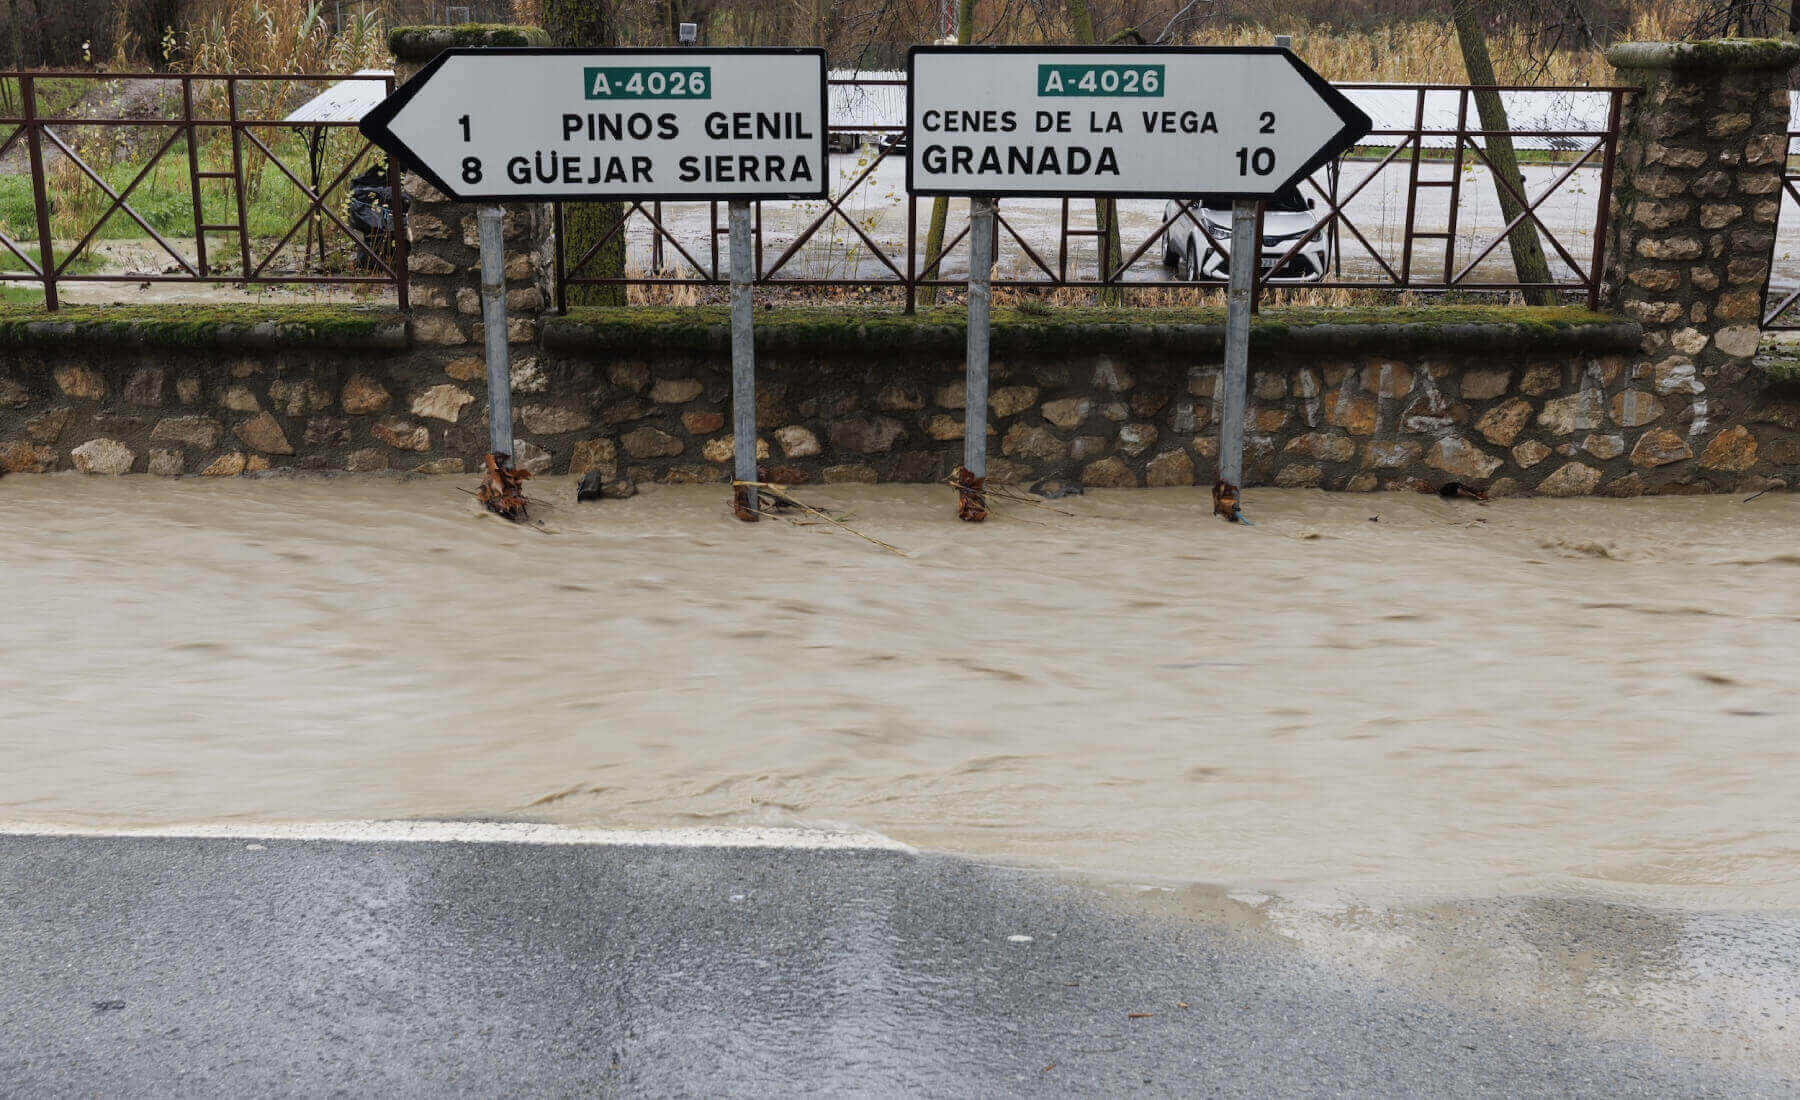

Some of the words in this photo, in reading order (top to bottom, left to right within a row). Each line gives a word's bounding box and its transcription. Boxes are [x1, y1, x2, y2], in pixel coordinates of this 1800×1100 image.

[592, 71, 706, 95] A-4026
[1045, 69, 1159, 92] A-4026
[458, 114, 472, 143] 1
[562, 112, 680, 142] PINOS
[704, 111, 813, 141] GENIL
[922, 109, 1018, 133] CENES
[1035, 110, 1072, 133] DE
[1089, 110, 1124, 134] LA
[1142, 110, 1219, 134] VEGA
[1259, 111, 1276, 134] 2
[461, 156, 483, 185] 8
[506, 150, 654, 185] GÜEJAR
[678, 154, 813, 184] SIERRA
[921, 144, 1121, 176] GRANADA
[1235, 146, 1276, 177] 10
